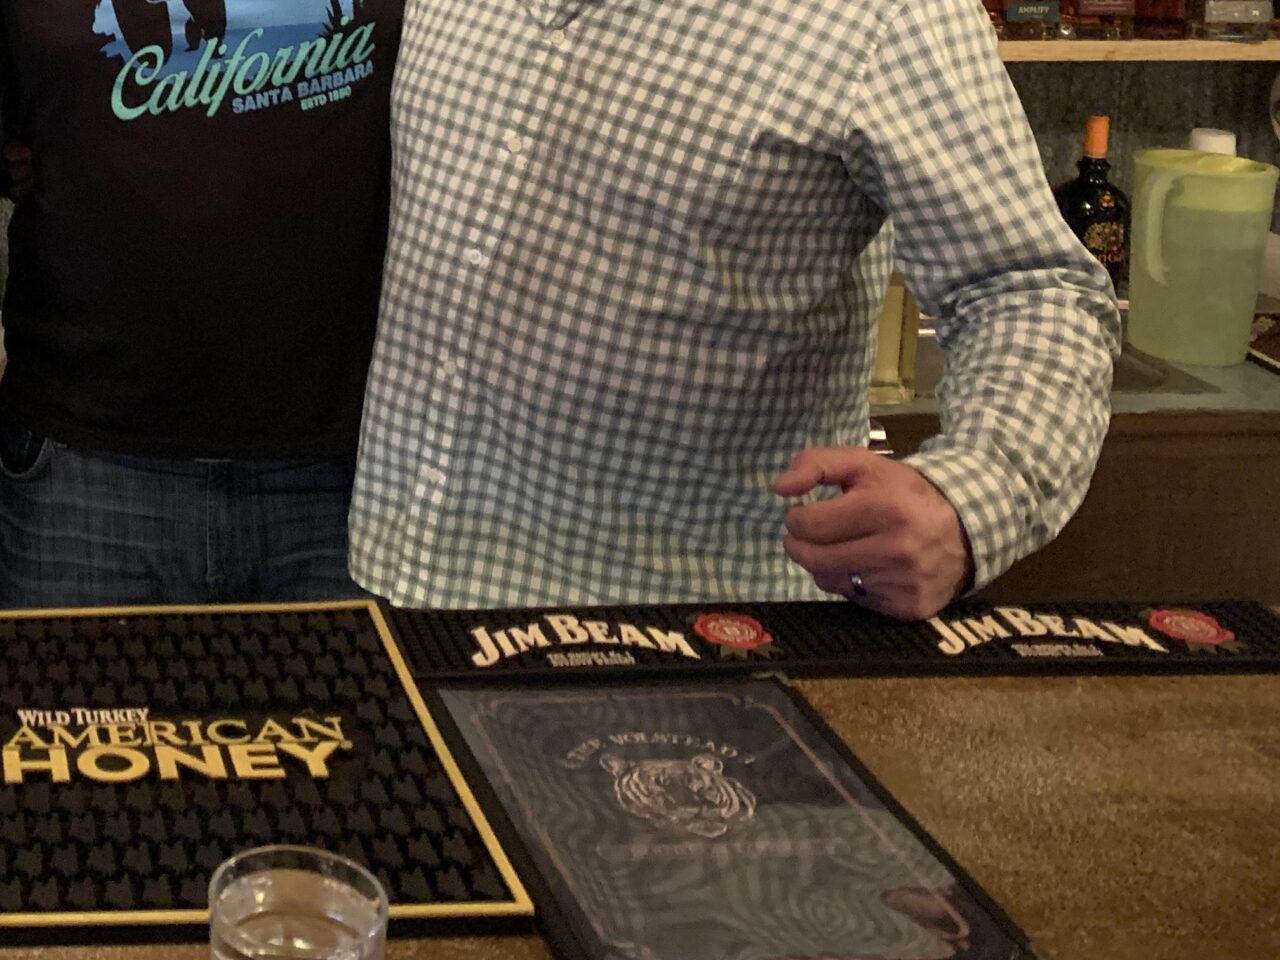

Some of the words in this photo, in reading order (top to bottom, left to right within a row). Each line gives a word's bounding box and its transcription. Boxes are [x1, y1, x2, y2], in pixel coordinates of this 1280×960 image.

[110, 14, 377, 122] California
[231, 83, 294, 116] SANTA
[297, 59, 375, 98] BARBARA
[470, 622, 553, 669] JIM
[542, 613, 703, 661] BEAM
[927, 613, 1013, 656] JIM
[992, 606, 1171, 654] BEAM
[6, 715, 343, 749] AMERICAN
[17, 708, 71, 727] WILD
[70, 706, 150, 727] TURKEY
[1, 740, 342, 785] HONEY
